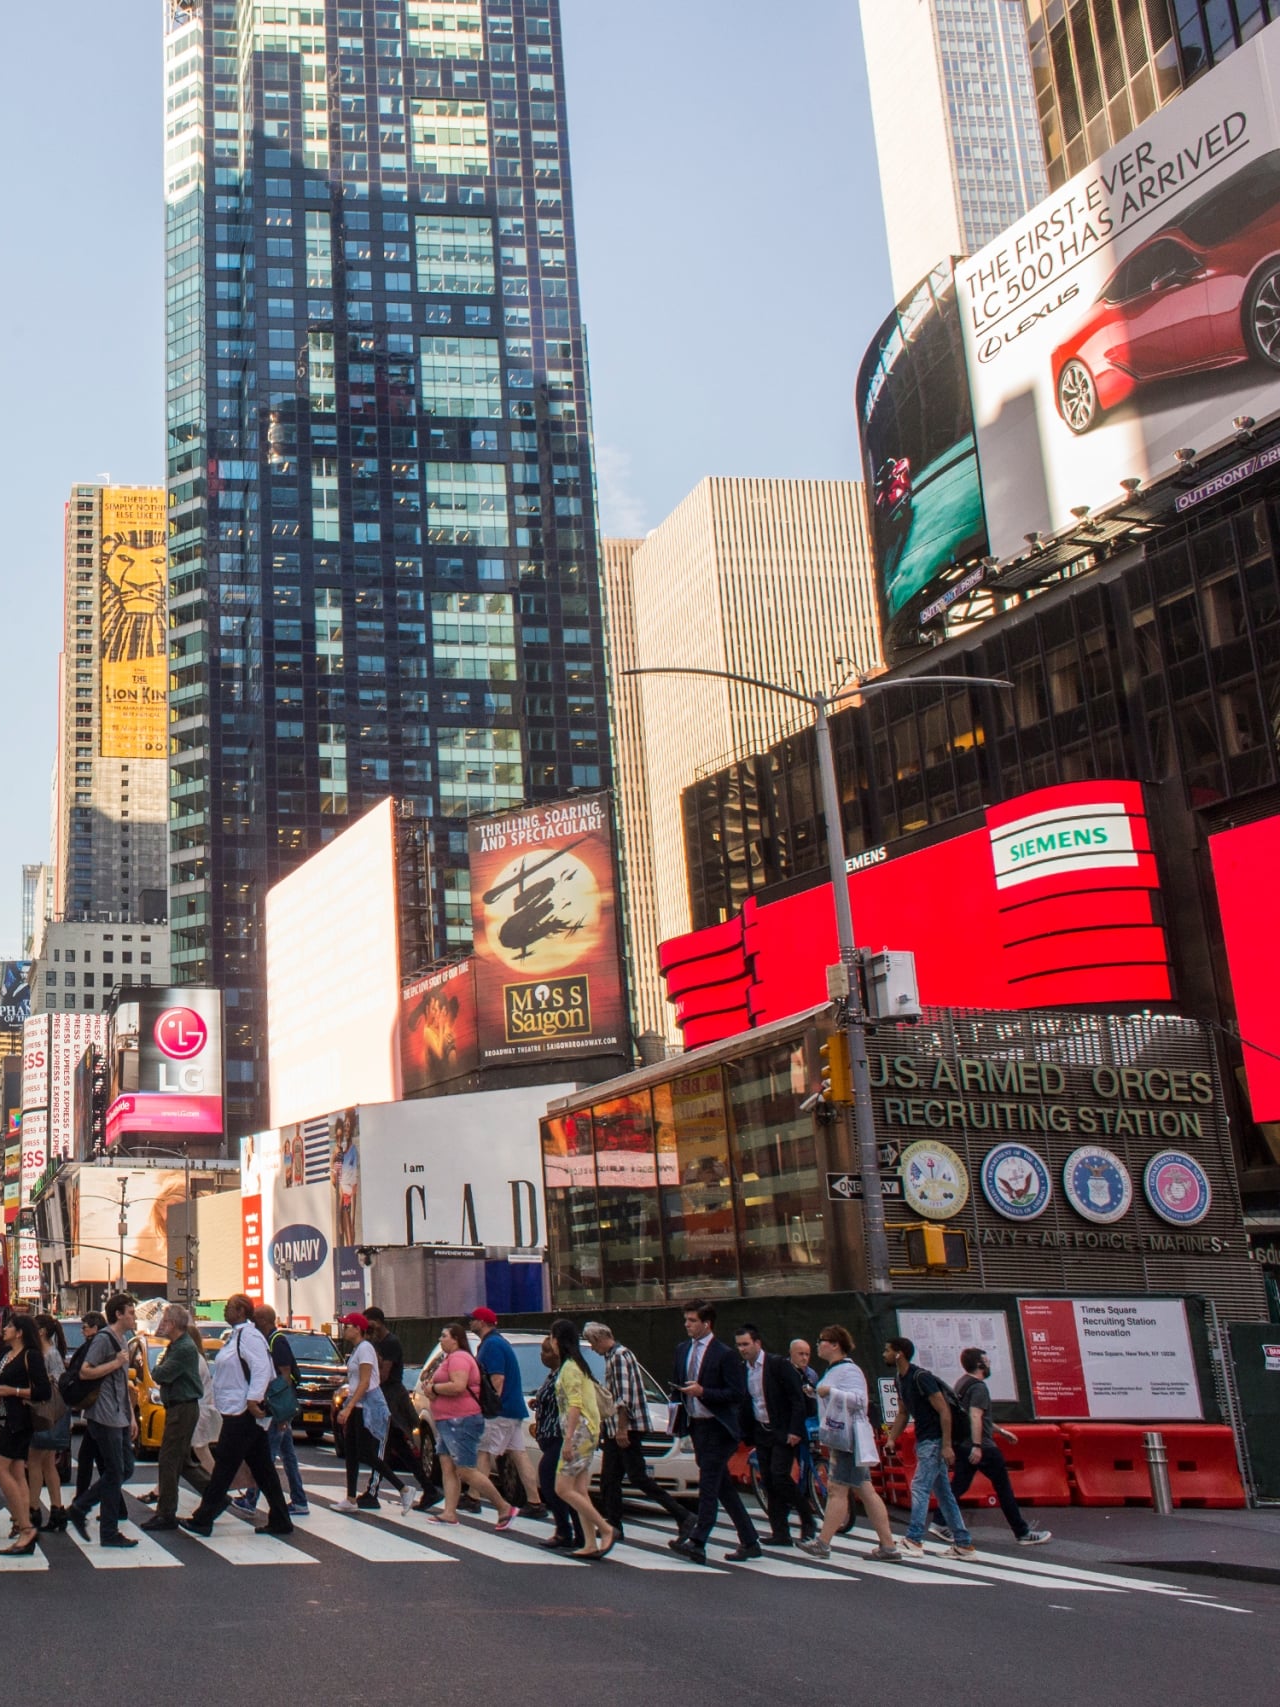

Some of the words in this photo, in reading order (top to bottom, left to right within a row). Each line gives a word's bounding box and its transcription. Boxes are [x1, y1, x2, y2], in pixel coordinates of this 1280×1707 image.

[966, 250, 1011, 298] THE
[1016, 141, 1157, 264] FIRST-EVER
[972, 291, 1002, 329] LC
[1007, 252, 1054, 304] 500
[1059, 208, 1113, 265] HAS
[1120, 112, 1247, 223] ARRIVED
[1005, 283, 1079, 343] LEXUS
[1179, 463, 1251, 508] OUTFRONT
[106, 685, 138, 703] LION
[142, 686, 166, 704] KIN
[481, 836, 506, 852] AND
[1010, 827, 1108, 862] SIEMENS
[845, 846, 887, 873] EMENS
[511, 1006, 586, 1035] Saigon
[484, 1048, 516, 1058] BROADWAY
[158, 1063, 205, 1093] LG
[932, 1057, 1067, 1096] ARMED
[884, 1099, 1071, 1133] RECRUITING
[1077, 1106, 1204, 1138] STATION
[403, 1163, 407, 1173] I
[409, 1164, 425, 1173] am
[839, 1181, 861, 1193] ONE
[880, 1183, 895, 1193] AY
[274, 1240, 292, 1264] OLD
[292, 1238, 321, 1262] NAVY
[968, 1229, 1018, 1246] NAVY
[1042, 1230, 1069, 1247] AIR
[1074, 1231, 1133, 1250] FORCE
[1149, 1232, 1221, 1253] MARINES
[1081, 1305, 1106, 1314] Times
[1107, 1306, 1137, 1316] Square
[1082, 1317, 1125, 1327] Recruiting
[1127, 1317, 1156, 1326] Station
[1084, 1328, 1131, 1337] Renovation
